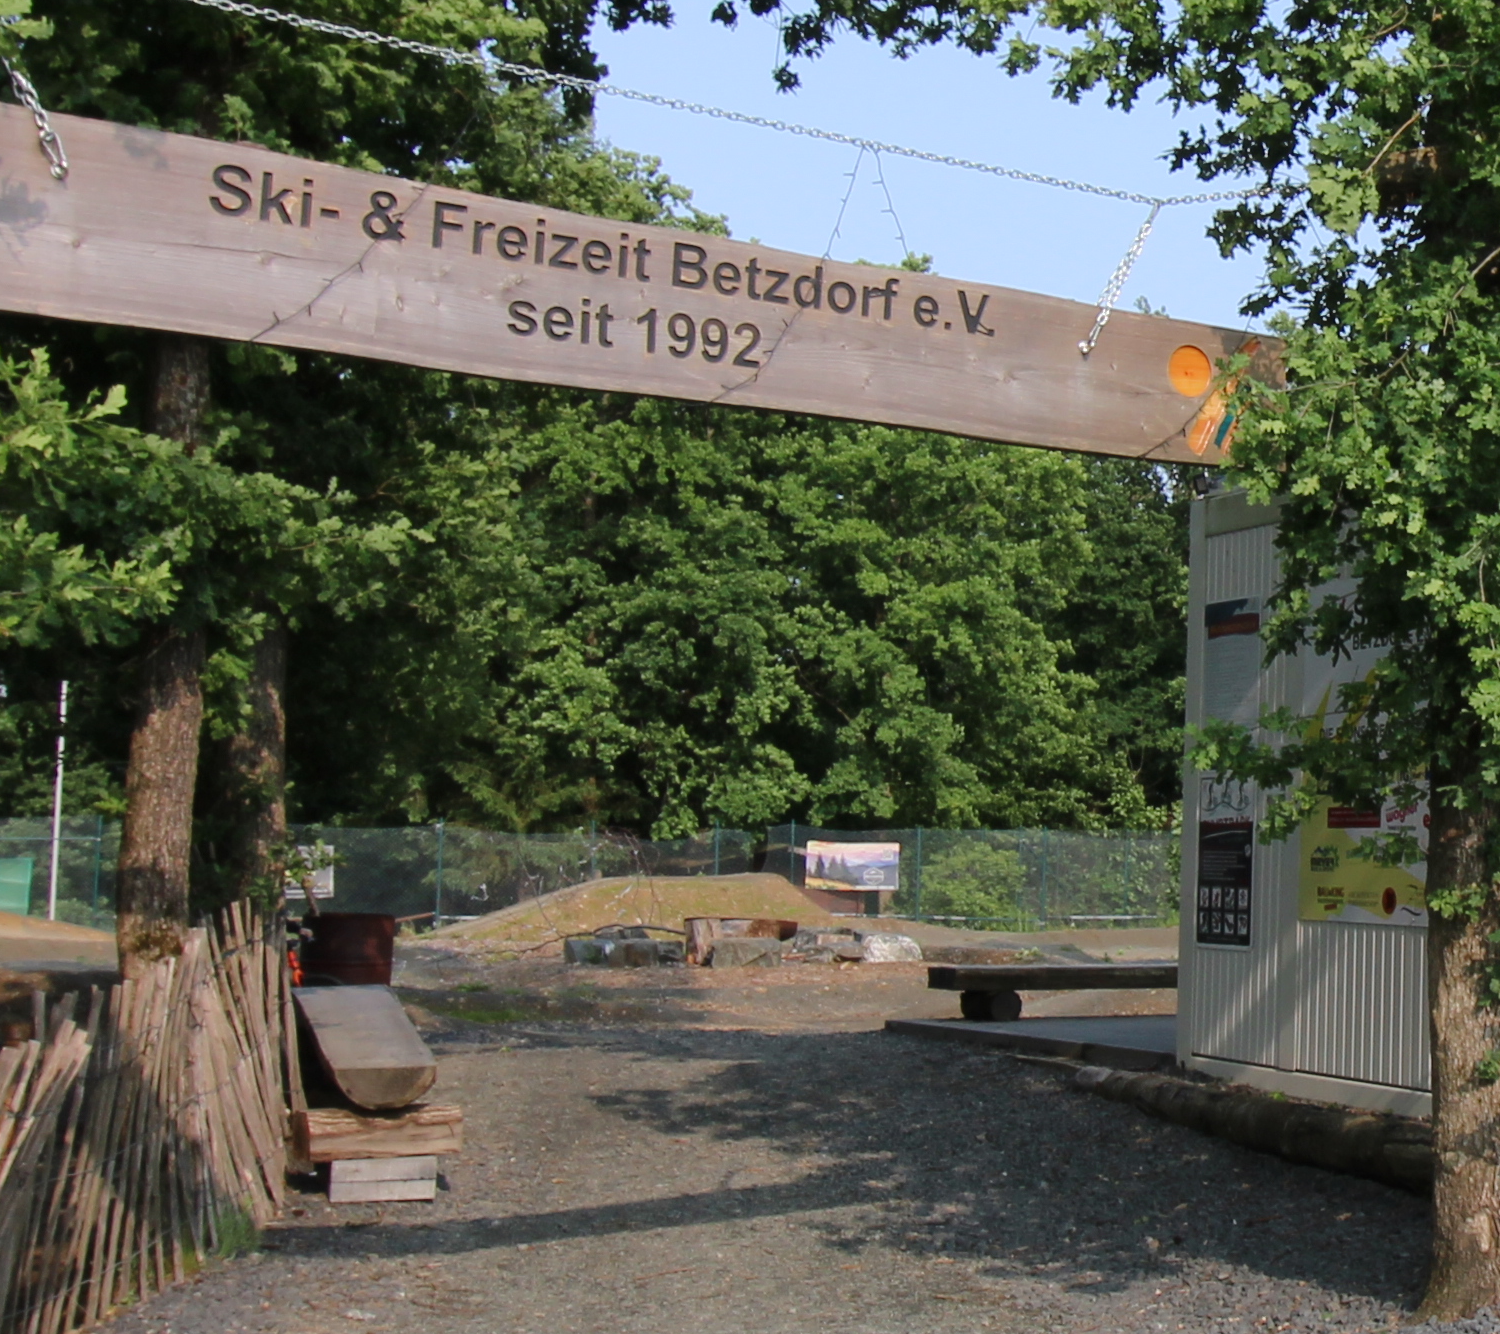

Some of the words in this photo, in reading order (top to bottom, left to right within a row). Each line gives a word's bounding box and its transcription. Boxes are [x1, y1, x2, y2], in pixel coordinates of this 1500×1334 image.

[209, 164, 340, 229] Ski-
[362, 191, 406, 241] &
[432, 200, 651, 284] Freizeit
[671, 241, 900, 322] Betzdorf
[506, 299, 614, 349] seit
[636, 307, 762, 369] 1992
